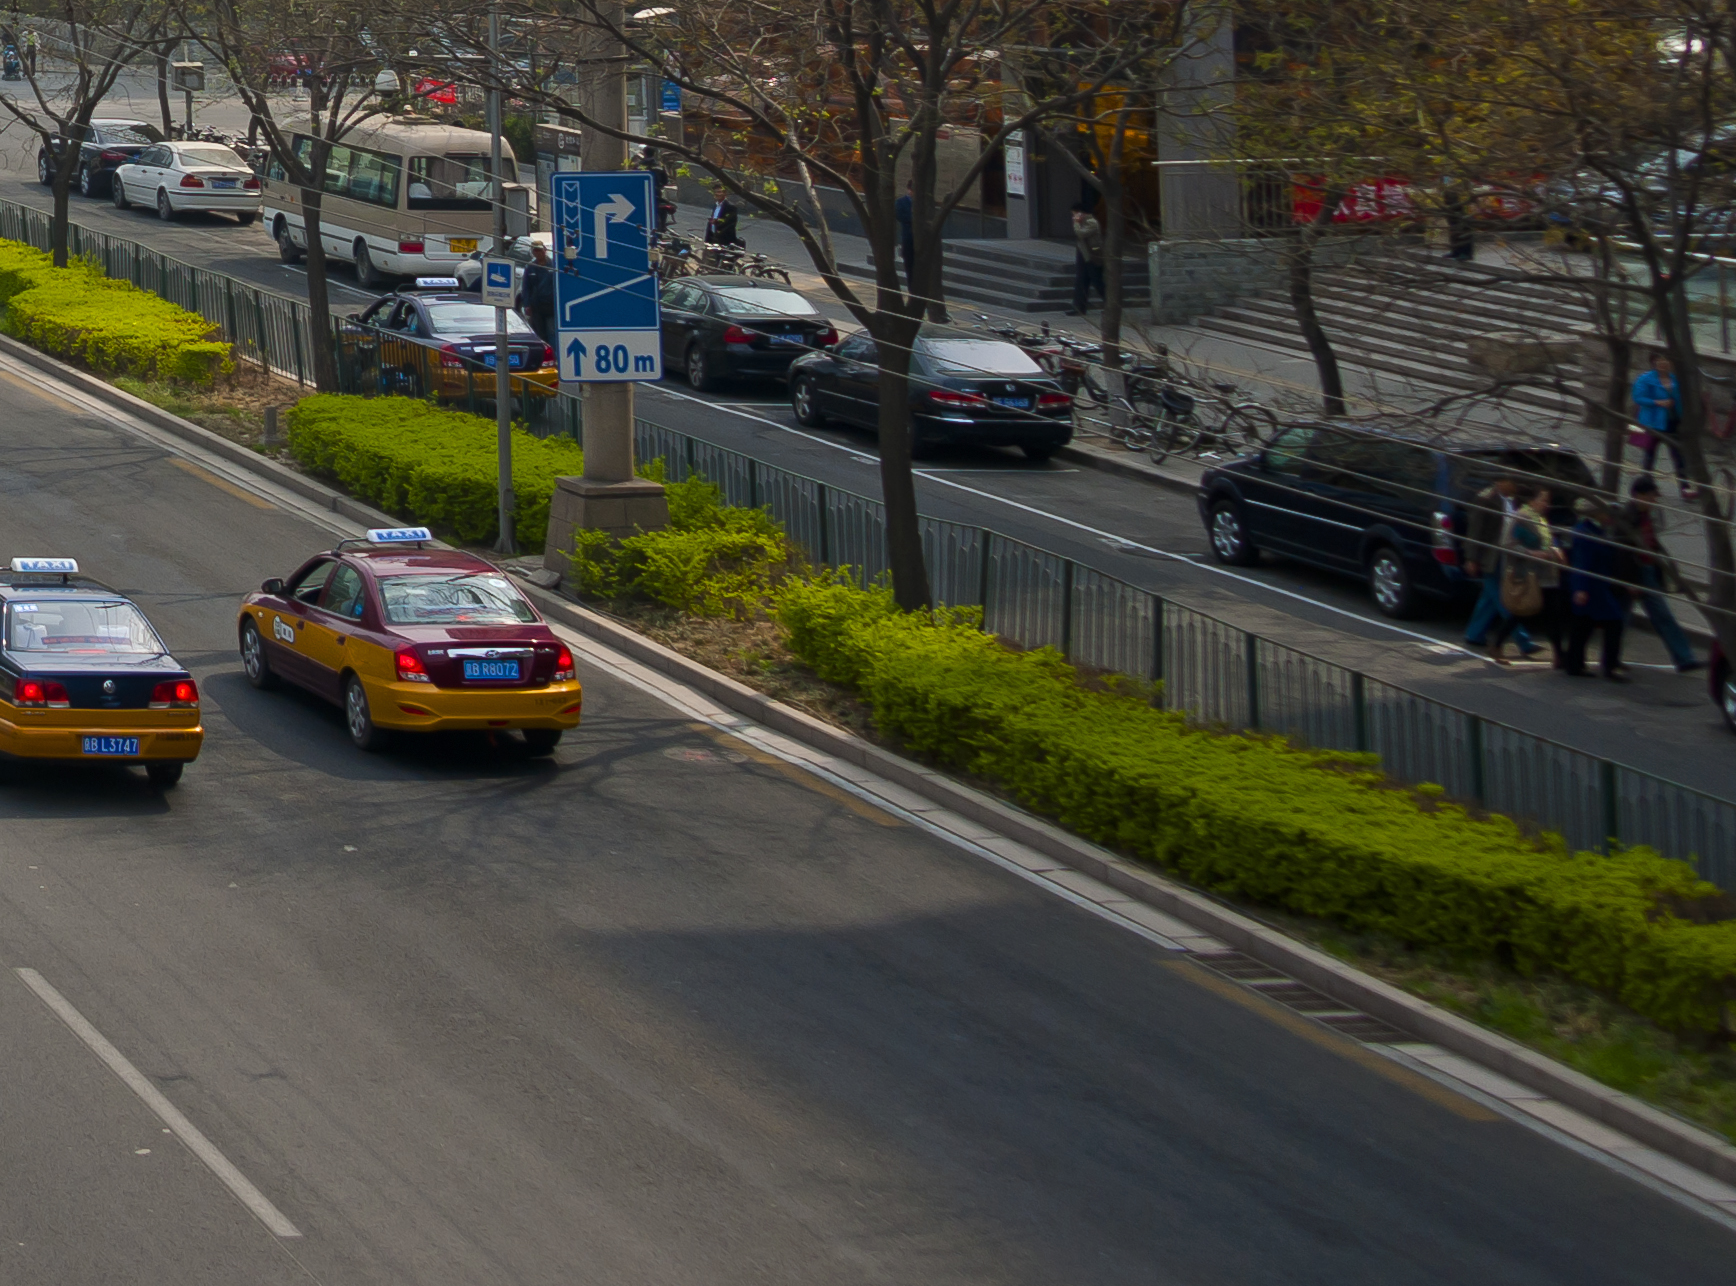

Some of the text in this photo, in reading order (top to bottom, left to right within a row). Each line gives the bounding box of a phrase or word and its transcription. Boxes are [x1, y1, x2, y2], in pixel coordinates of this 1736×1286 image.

[594, 344, 656, 374] 80 m
[380, 529, 426, 540] TAXI
[27, 560, 71, 571] TAXI
[482, 662, 518, 677] R8072
[101, 738, 138, 753] L3747
